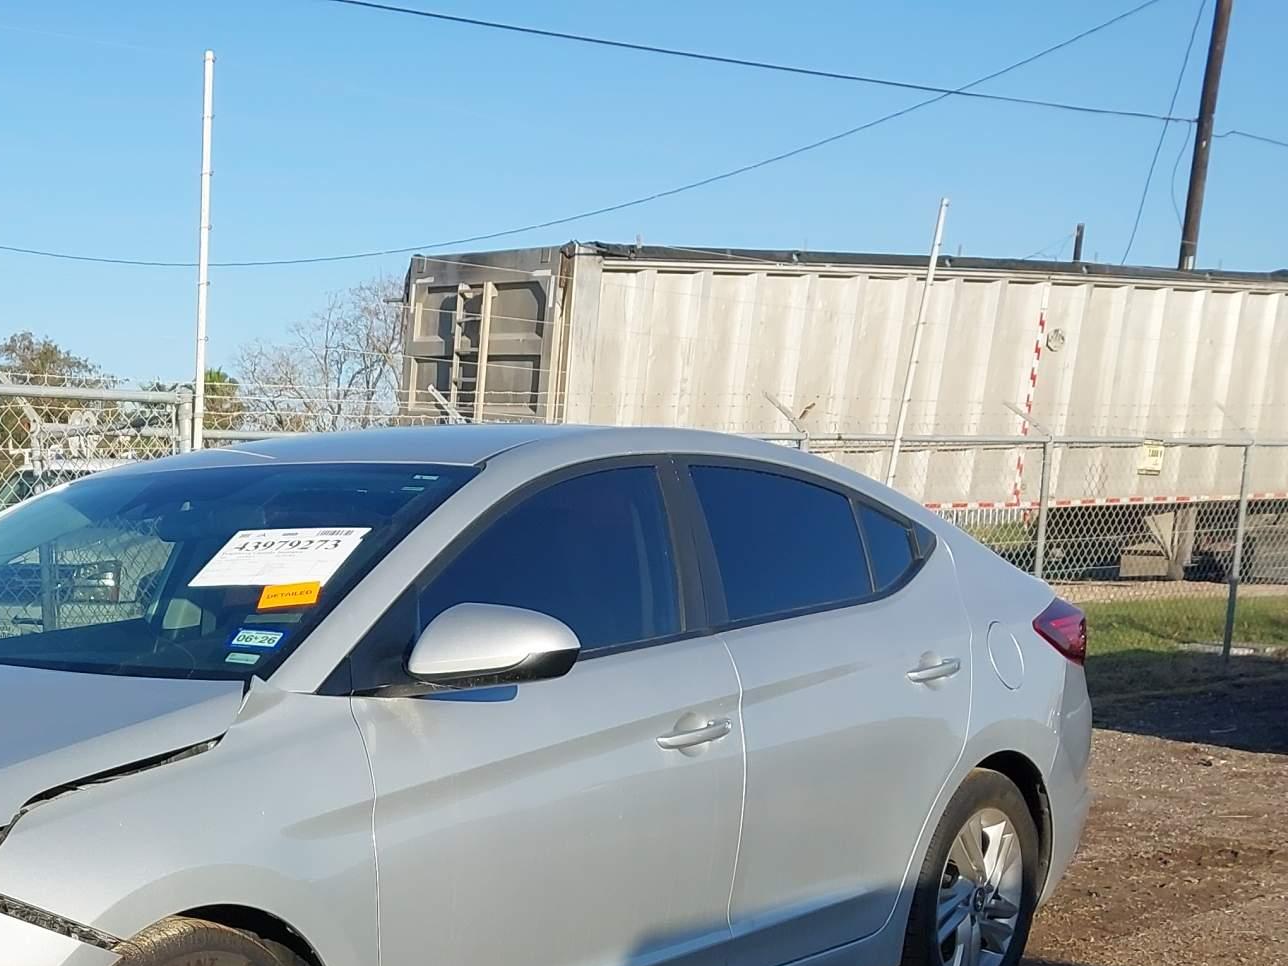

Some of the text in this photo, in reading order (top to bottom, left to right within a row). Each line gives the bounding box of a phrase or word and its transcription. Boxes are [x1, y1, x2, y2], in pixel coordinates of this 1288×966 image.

[234, 539, 342, 552] 43979273
[265, 589, 314, 599] DETAILED
[236, 634, 278, 645] 06 26
